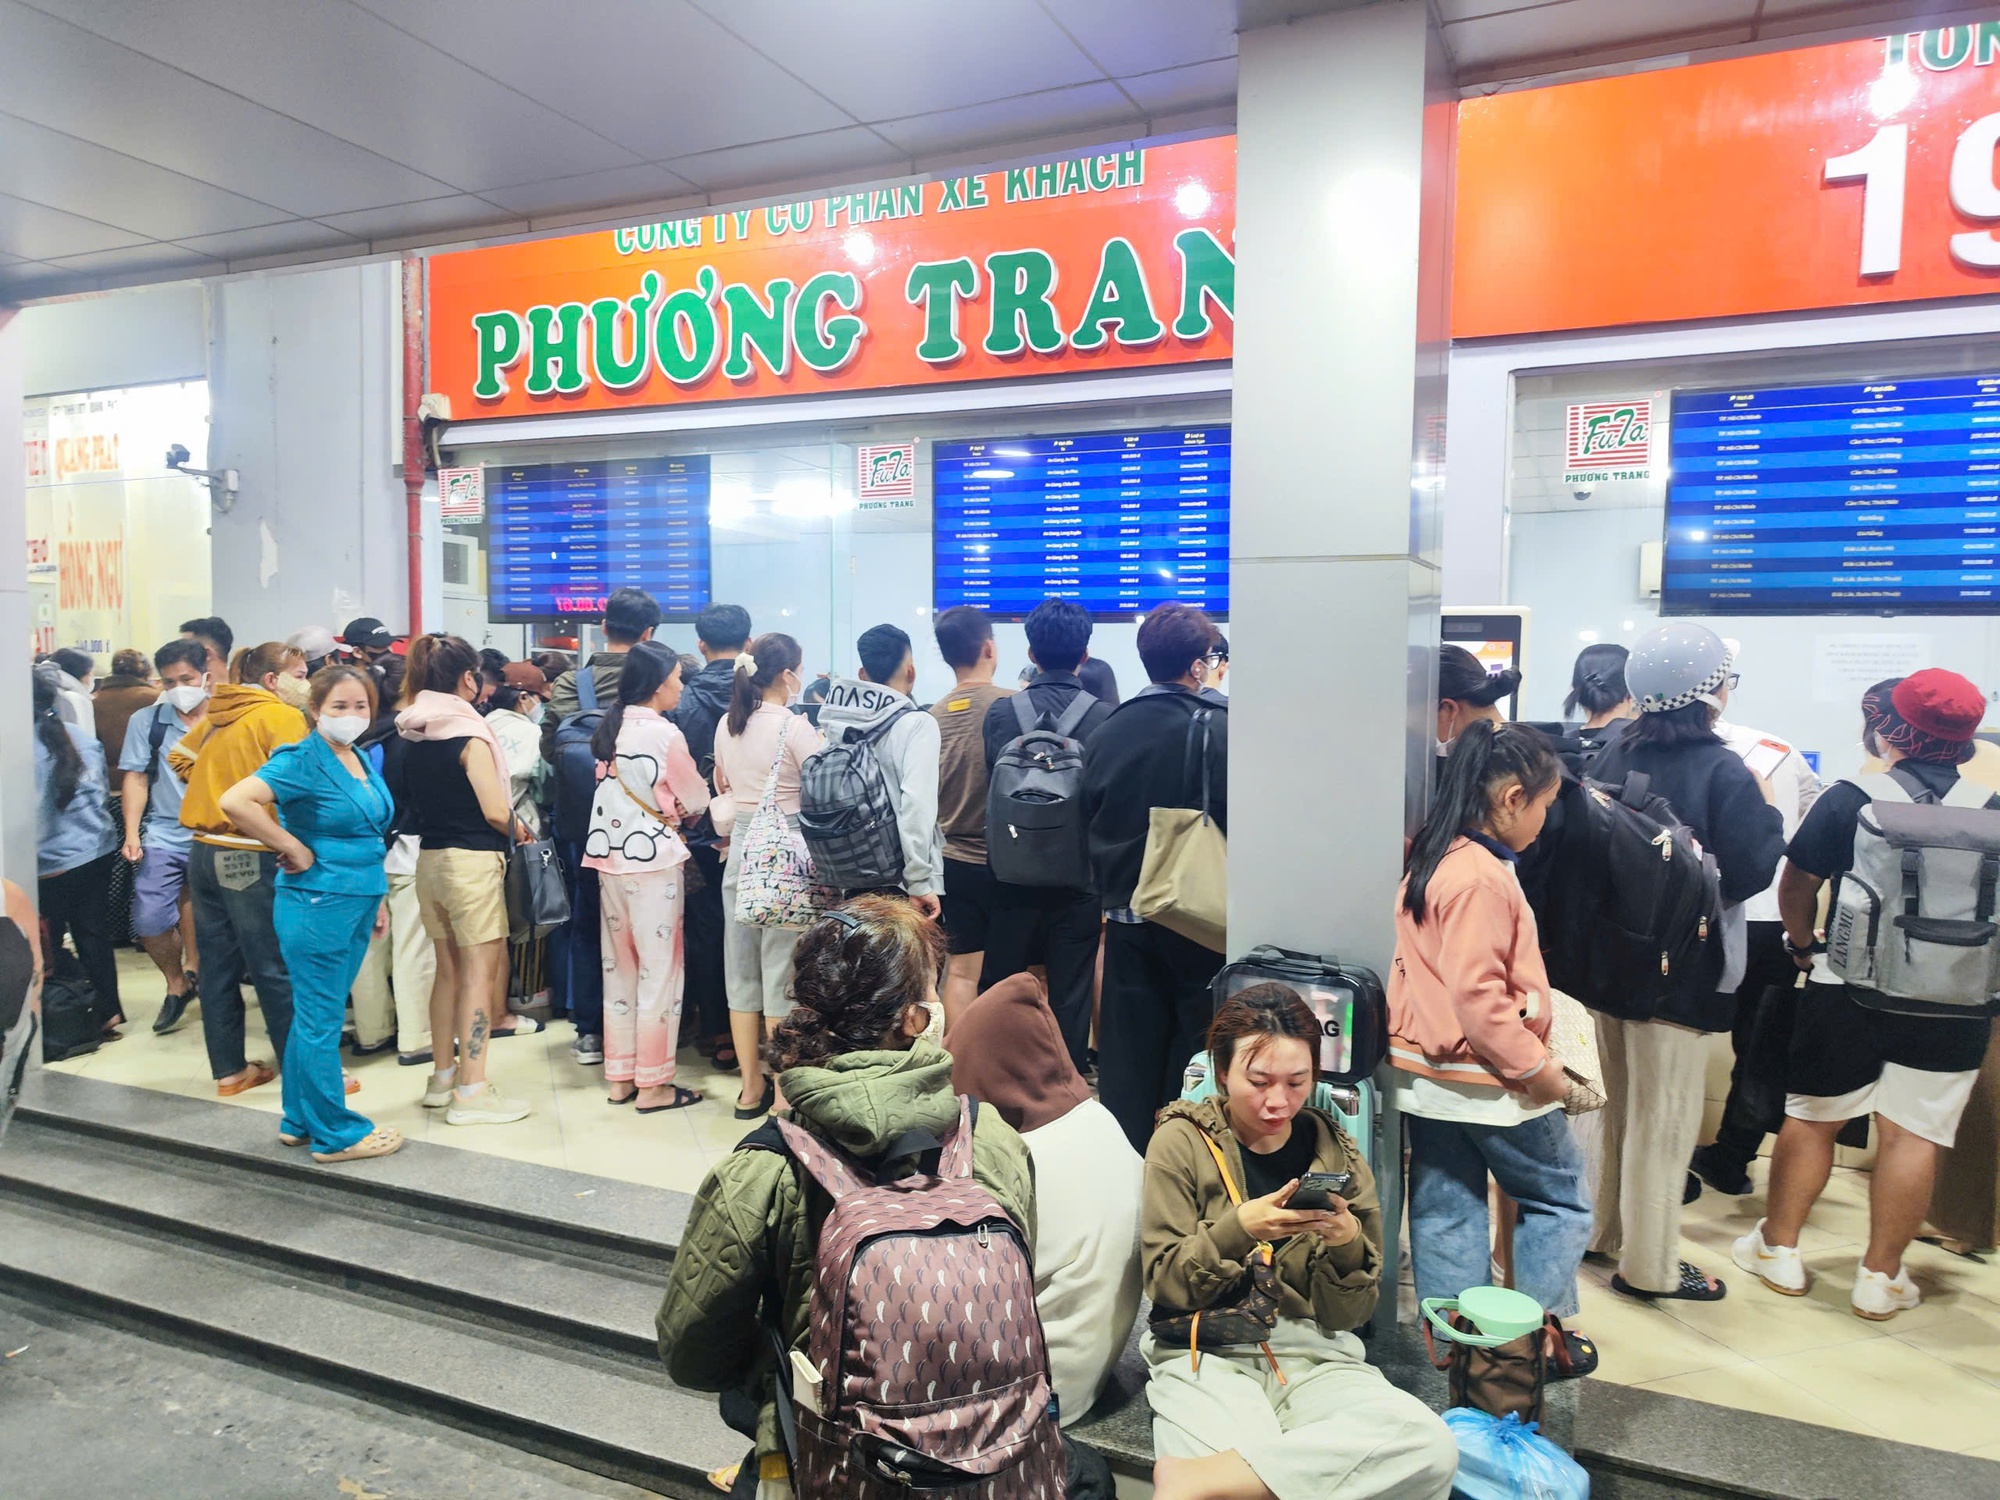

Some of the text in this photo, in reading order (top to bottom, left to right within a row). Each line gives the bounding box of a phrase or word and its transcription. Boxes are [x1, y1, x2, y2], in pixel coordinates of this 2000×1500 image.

[938, 174, 989, 213] XE
[472, 265, 868, 400] PHƯƠNG
[1613, 471, 1650, 481] TRANG
[1833, 906, 1855, 969] LANGMU
